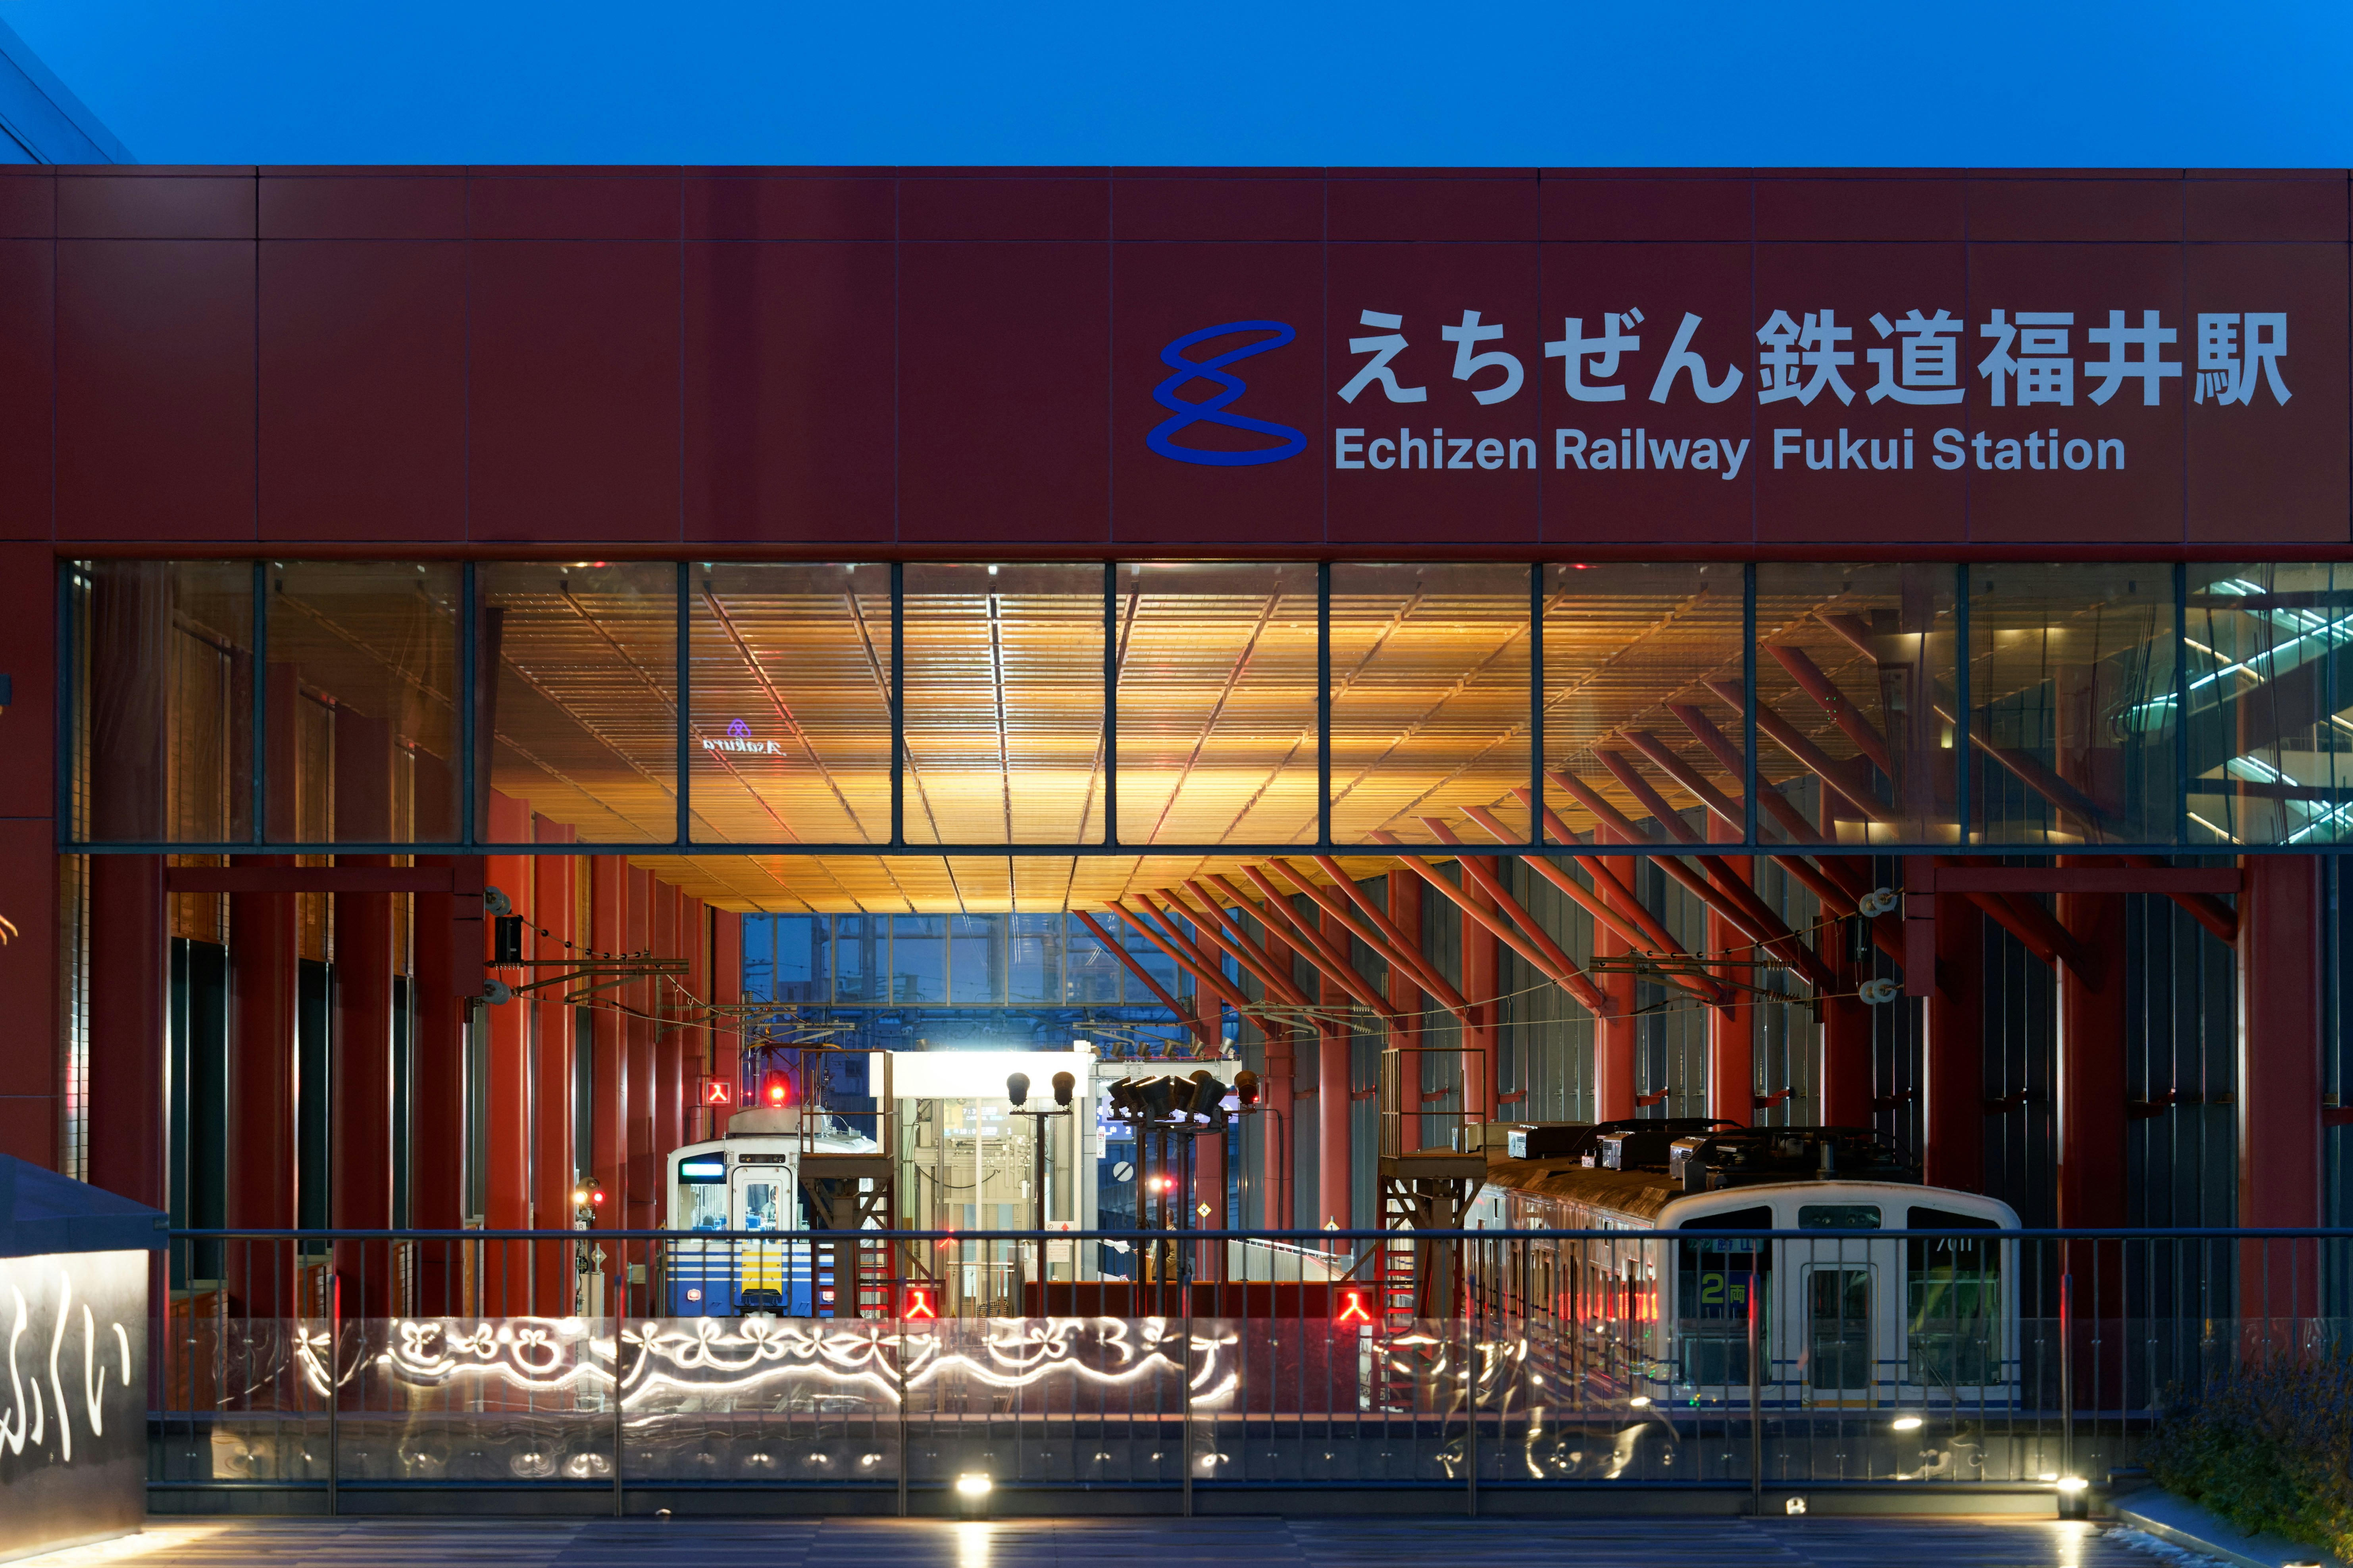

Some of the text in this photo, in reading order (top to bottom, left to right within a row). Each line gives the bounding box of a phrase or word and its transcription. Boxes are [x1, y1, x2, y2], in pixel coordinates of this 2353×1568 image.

[1337, 306, 2292, 407] えちぜん鉄道福井駅
[1336, 428, 2124, 480] Echizen Railway Fukui Station
[1125, 1126, 1131, 1134] 2
[1701, 1273, 1745, 1304] 2両
